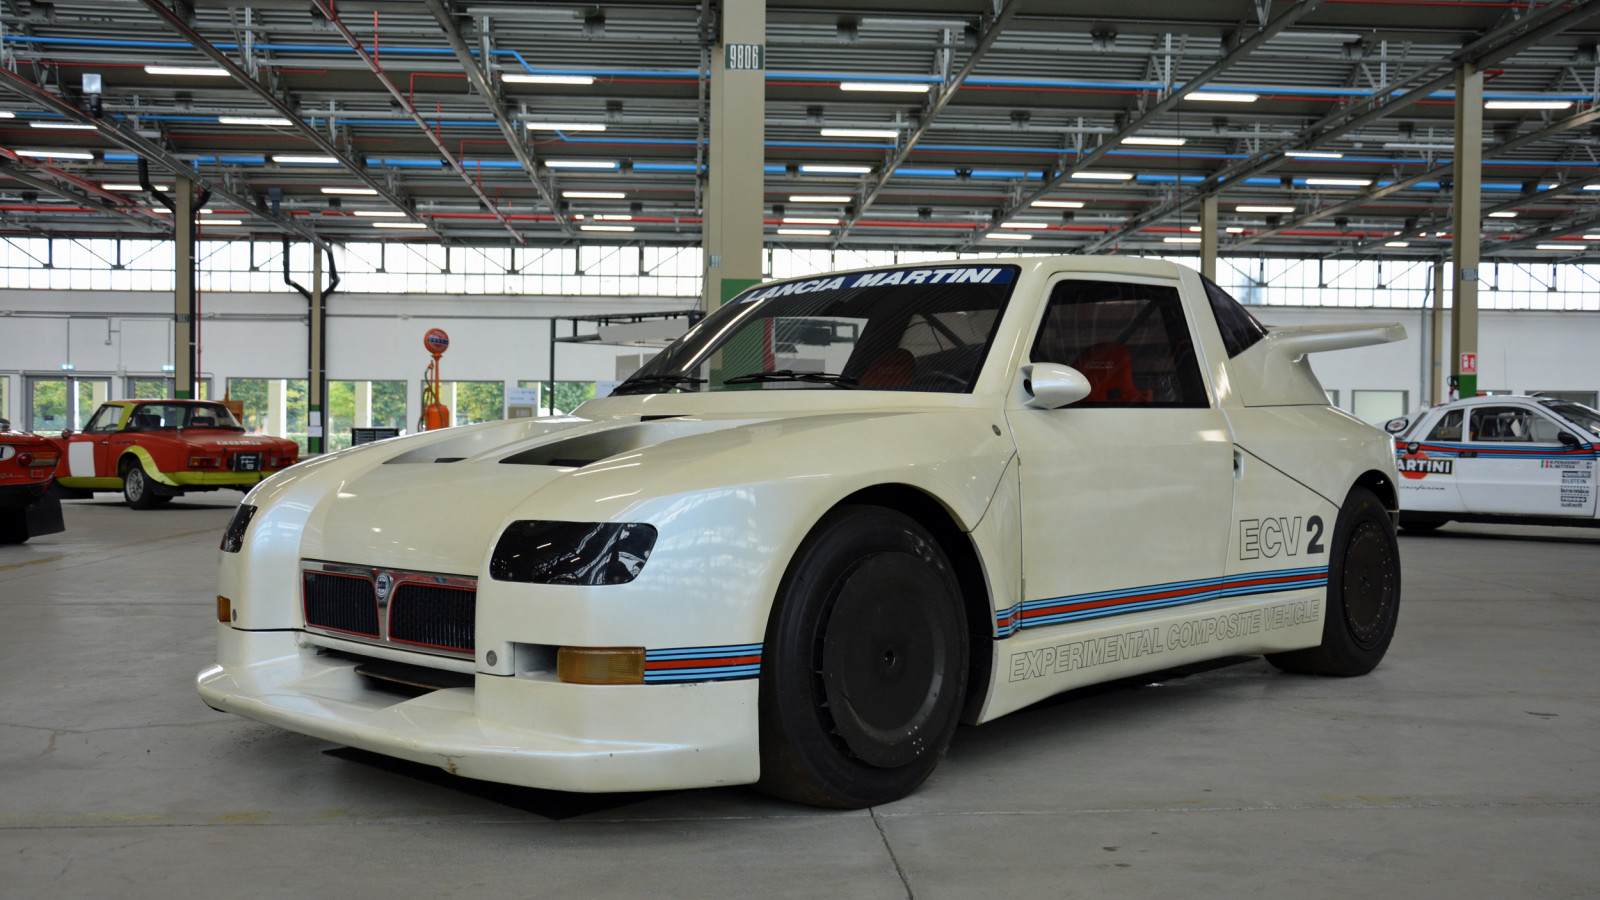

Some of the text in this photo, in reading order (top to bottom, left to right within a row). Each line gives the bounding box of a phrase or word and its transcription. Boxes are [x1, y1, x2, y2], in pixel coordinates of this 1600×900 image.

[729, 44, 759, 69] 9806
[740, 268, 1002, 304] LANCIA MARTINI
[1397, 459, 1450, 473] ARTINI
[1239, 515, 1325, 560] ECV 2
[1008, 599, 1320, 682] EXPERIMENTAL COMPOSITE VEHICLE
